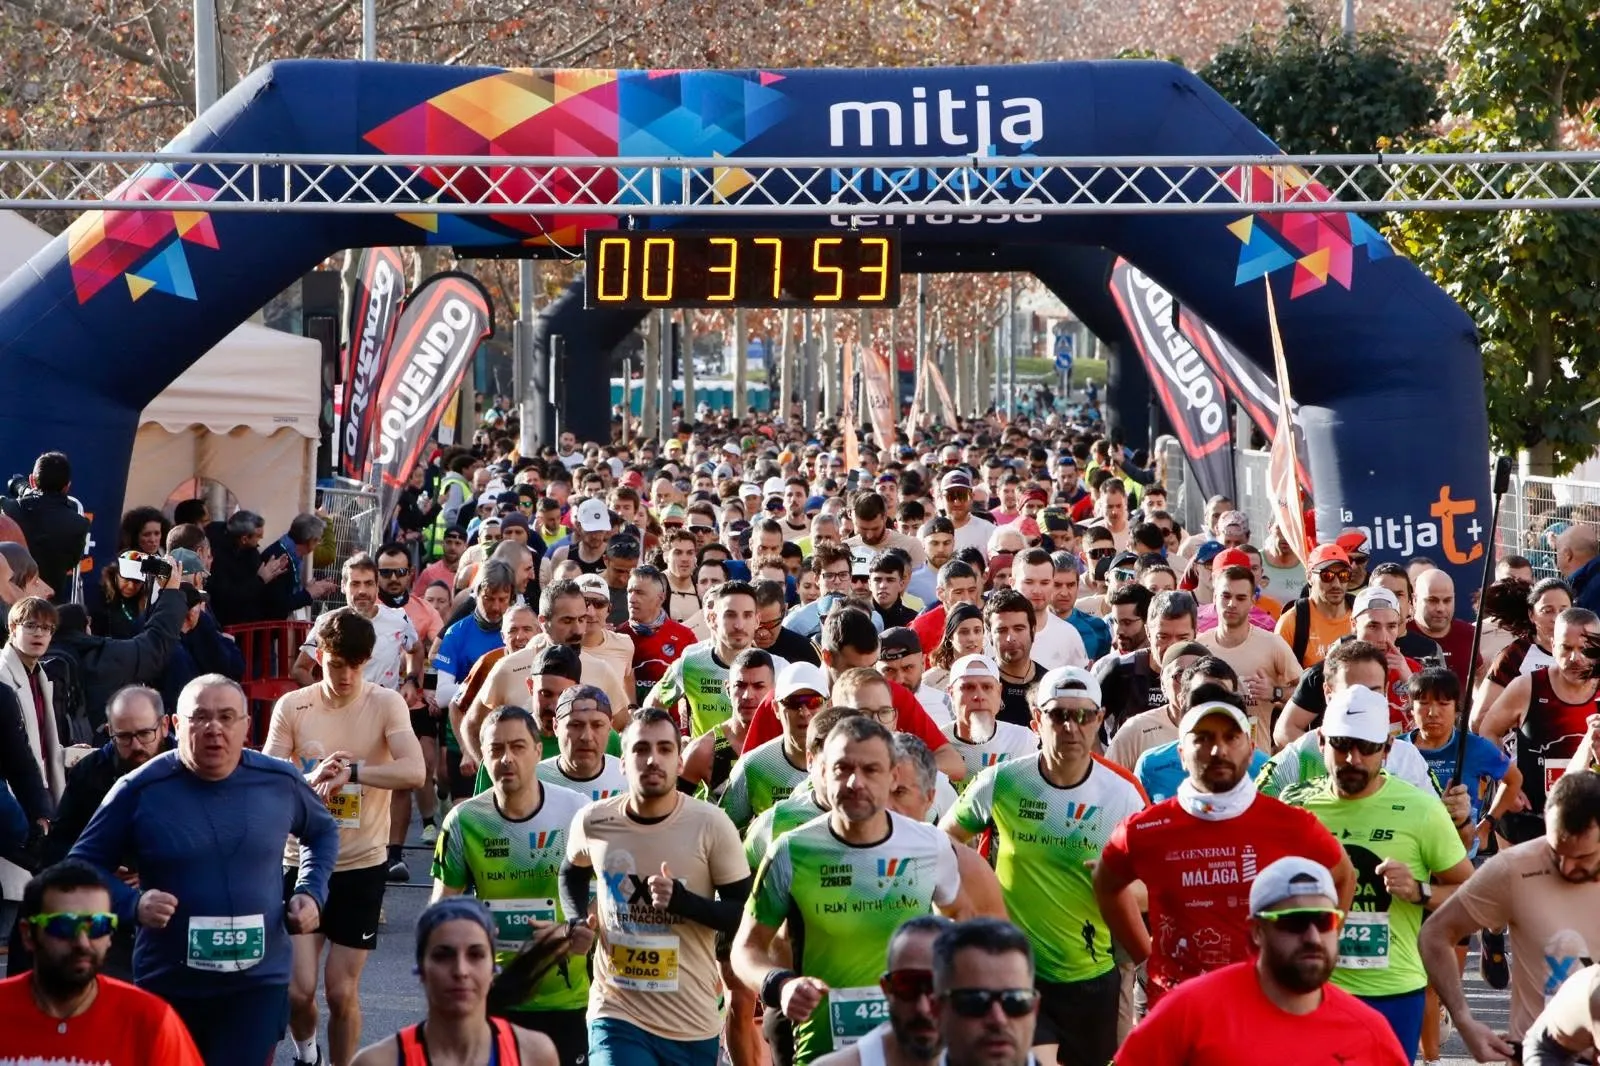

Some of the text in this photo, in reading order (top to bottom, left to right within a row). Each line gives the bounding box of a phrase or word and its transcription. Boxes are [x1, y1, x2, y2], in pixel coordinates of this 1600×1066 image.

[830, 85, 1043, 157] mitja
[598, 238, 888, 300] 00 37 53
[1340, 508, 1353, 522] la
[1181, 847, 1236, 859] GENERALI
[1181, 868, 1239, 887] MÁLAGA
[824, 902, 847, 914] RUN
[852, 899, 882, 913] WITH
[212, 930, 247, 946] 559
[626, 948, 660, 963] 749
